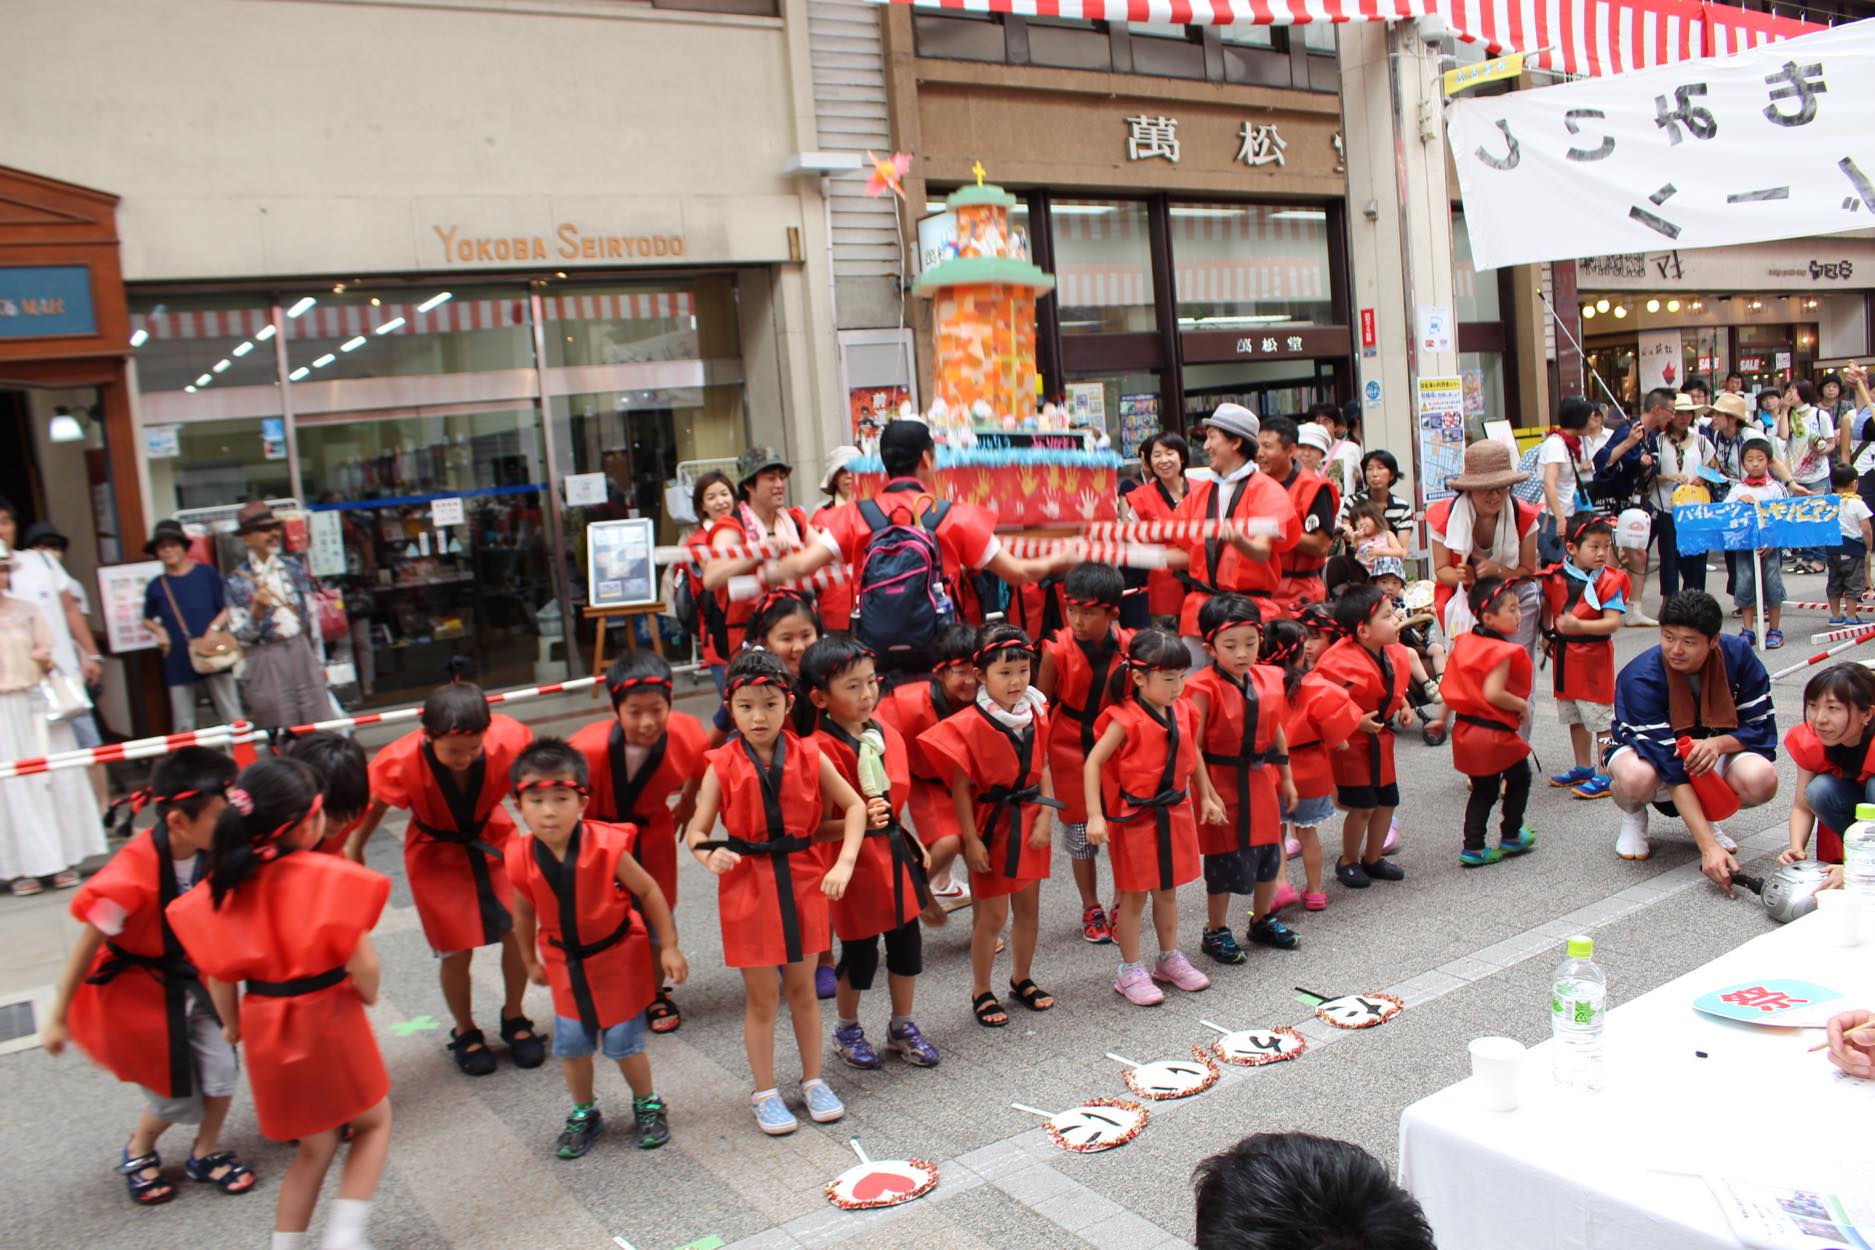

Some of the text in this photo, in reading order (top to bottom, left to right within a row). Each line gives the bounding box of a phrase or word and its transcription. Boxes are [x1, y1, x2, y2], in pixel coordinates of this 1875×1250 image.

[1124, 114, 1345, 174] 萬松
[434, 224, 686, 263] YOKOBA SEIRYODO
[1698, 357, 1721, 370] SAE
[1677, 503, 1742, 523] パイレーツ
